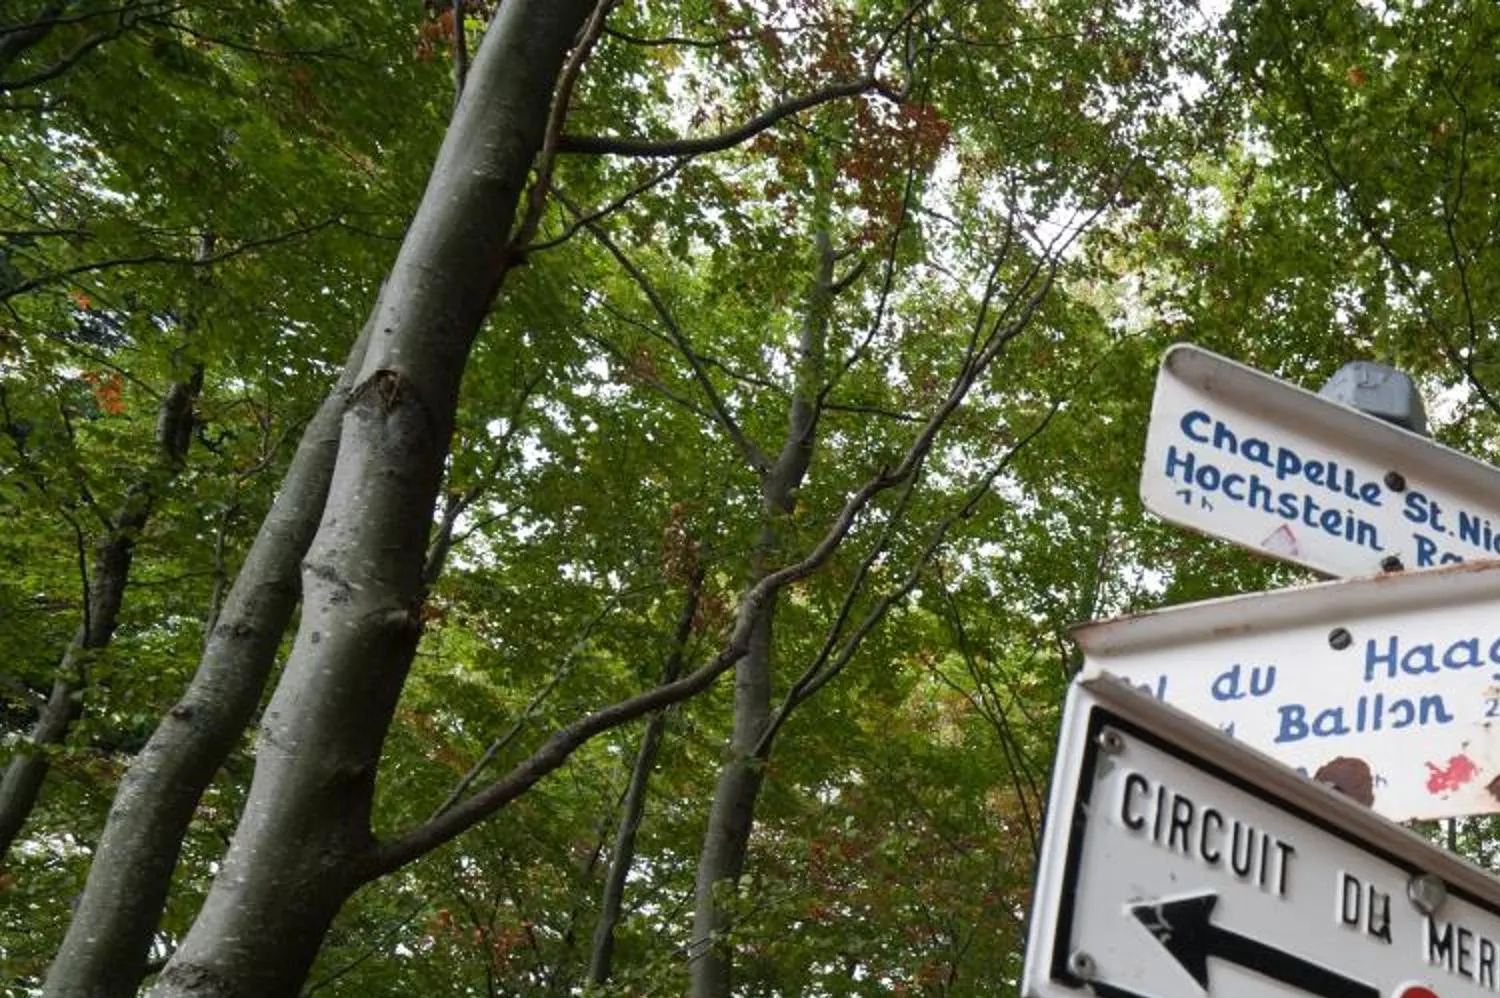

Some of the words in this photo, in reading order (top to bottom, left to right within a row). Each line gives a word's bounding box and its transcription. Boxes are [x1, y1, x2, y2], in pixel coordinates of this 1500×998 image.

[1165, 445, 1385, 552] Hochstein
[1180, 410, 1382, 507] Chapelle
[1211, 664, 1276, 701] du
[1274, 693, 1454, 744] Ballon
[1120, 773, 1296, 896] CIRCUIT
